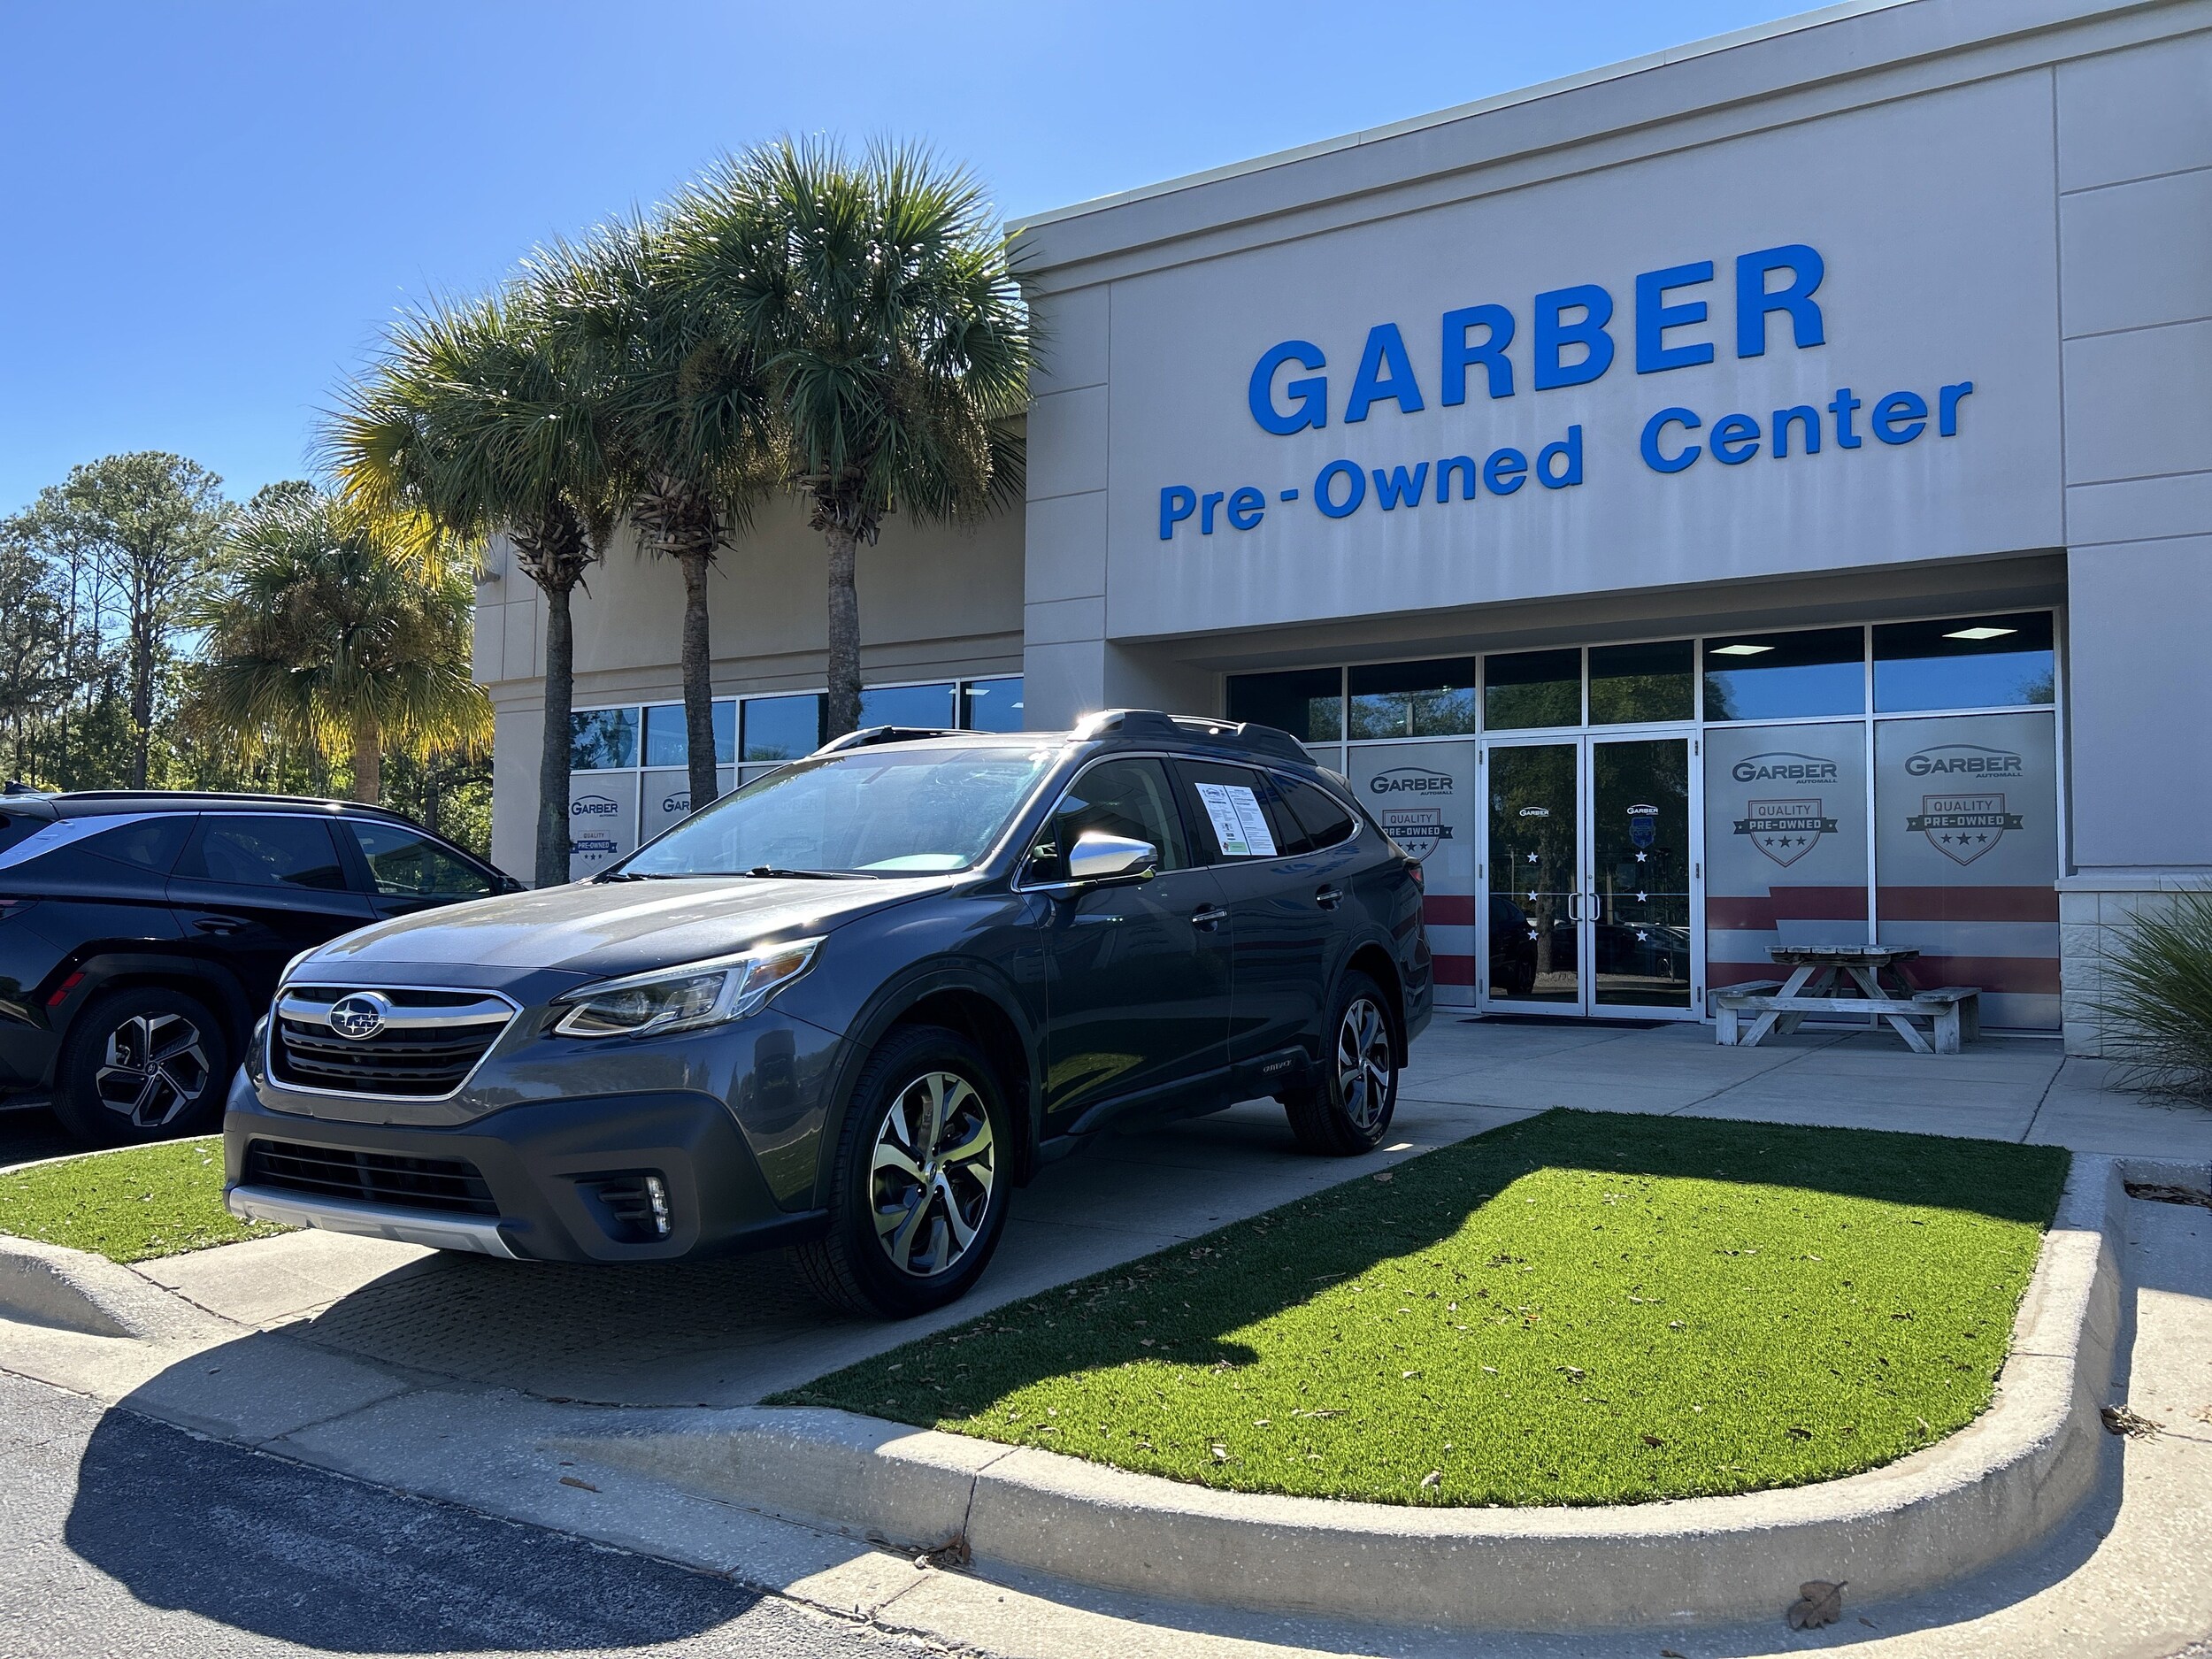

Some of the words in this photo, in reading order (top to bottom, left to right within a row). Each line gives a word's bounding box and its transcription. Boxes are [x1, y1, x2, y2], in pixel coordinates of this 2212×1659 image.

[1248, 243, 1825, 435] GARBER
[1640, 380, 1974, 472] Center
[1732, 762, 1838, 782] GARBER
[1904, 755, 2022, 776] GARBER
[1370, 776, 1453, 794] GARBER
[572, 802, 618, 815] GARBER
[662, 798, 690, 812] GAR
[1758, 804, 1811, 816] QUALITY
[1933, 800, 1993, 812] QUALITY
[1390, 813, 1432, 824] QUALITY
[1749, 819, 1822, 830] PRE-OWNED
[1924, 816, 2004, 826] PRE-OWNED
